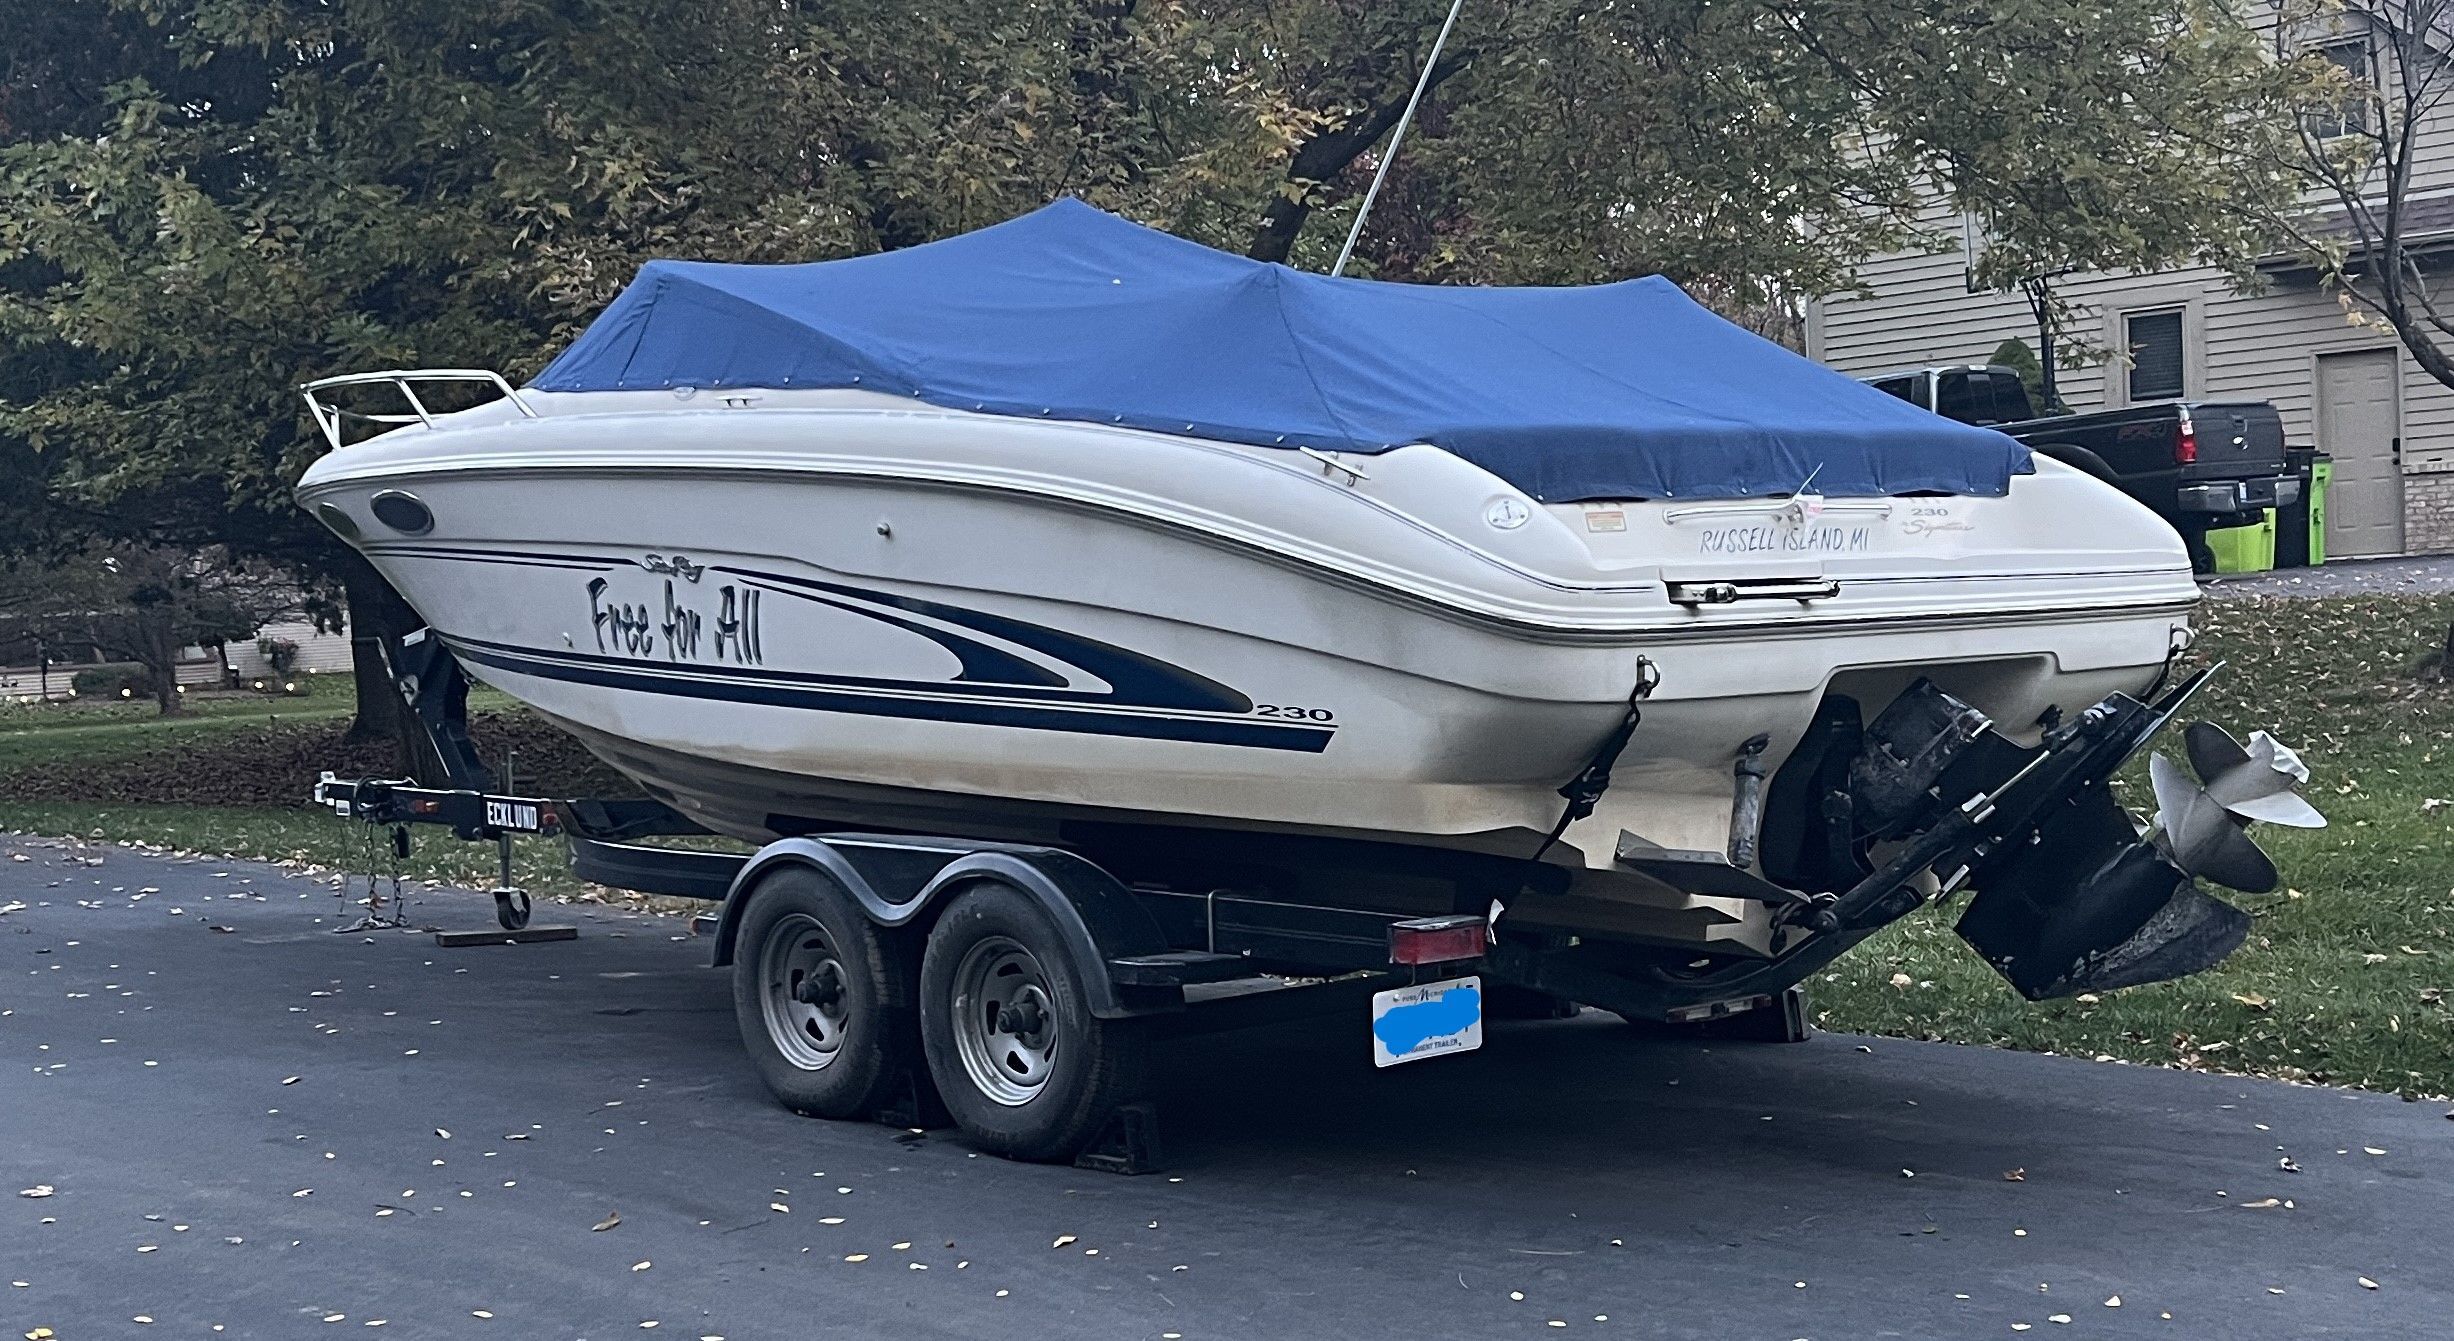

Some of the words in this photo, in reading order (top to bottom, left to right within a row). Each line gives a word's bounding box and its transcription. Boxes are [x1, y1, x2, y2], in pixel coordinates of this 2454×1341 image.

[1911, 508, 1949, 516] 230
[1700, 527, 1775, 554] RUSSELL
[1850, 527, 1869, 551] MI
[586, 577, 653, 656] Free
[661, 579, 701, 662] for
[714, 585, 763, 665] All
[1257, 704, 1334, 721] 230
[486, 801, 537, 830] ECKLUND
